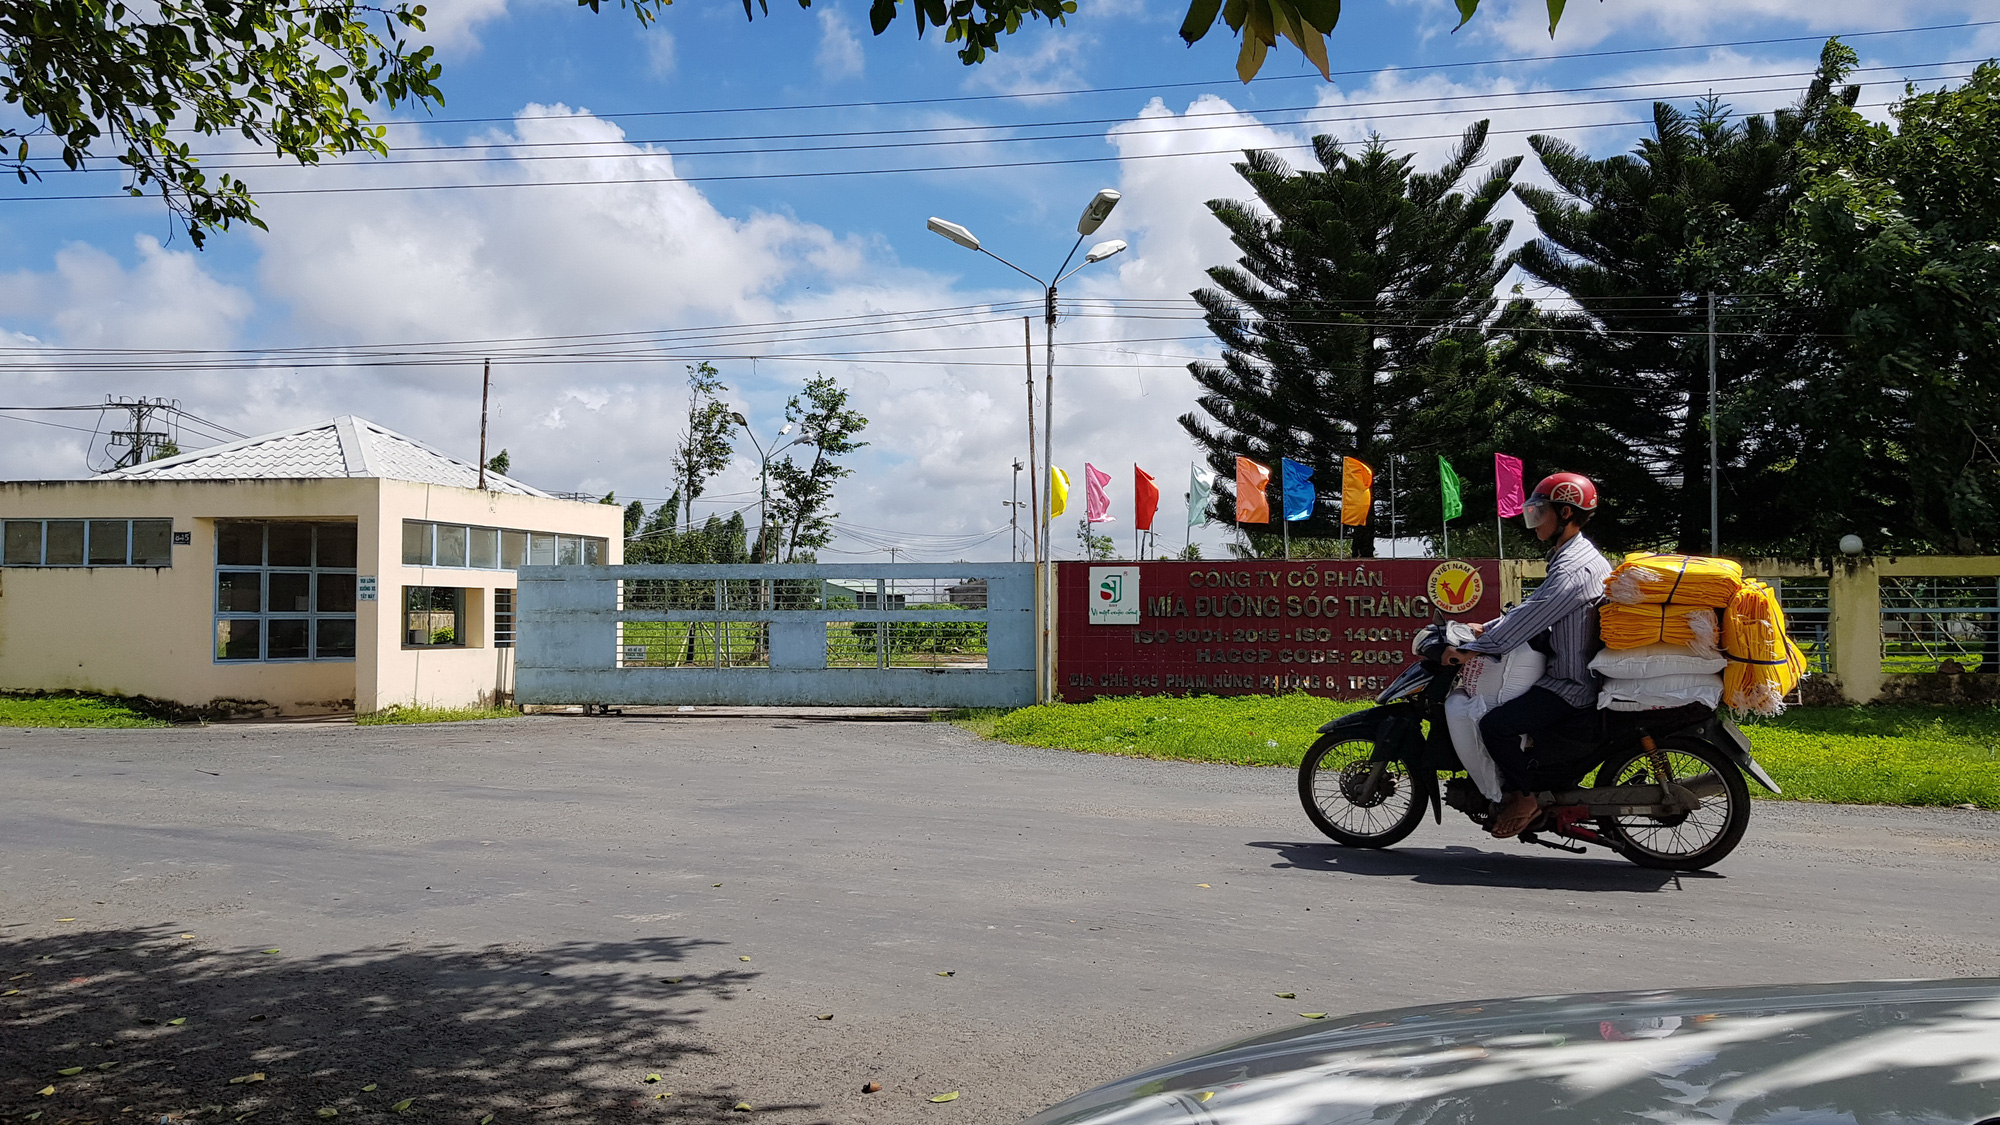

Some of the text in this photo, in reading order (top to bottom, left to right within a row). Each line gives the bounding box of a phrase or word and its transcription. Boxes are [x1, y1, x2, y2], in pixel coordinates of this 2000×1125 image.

[1189, 563, 1383, 588] CÔNG TY CỔ PHẦN
[1452, 563, 1471, 573] NAM
[1147, 590, 1430, 618] MÍA ĐƯỜNG SÓC TRĂNG
[1133, 629, 1170, 644] ISO
[1295, 627, 1332, 642] ISO
[1195, 648, 1404, 664] HACCP CODE: 2003
[1132, 674, 1159, 688] 845
[1212, 669, 1254, 689] HÙNG
